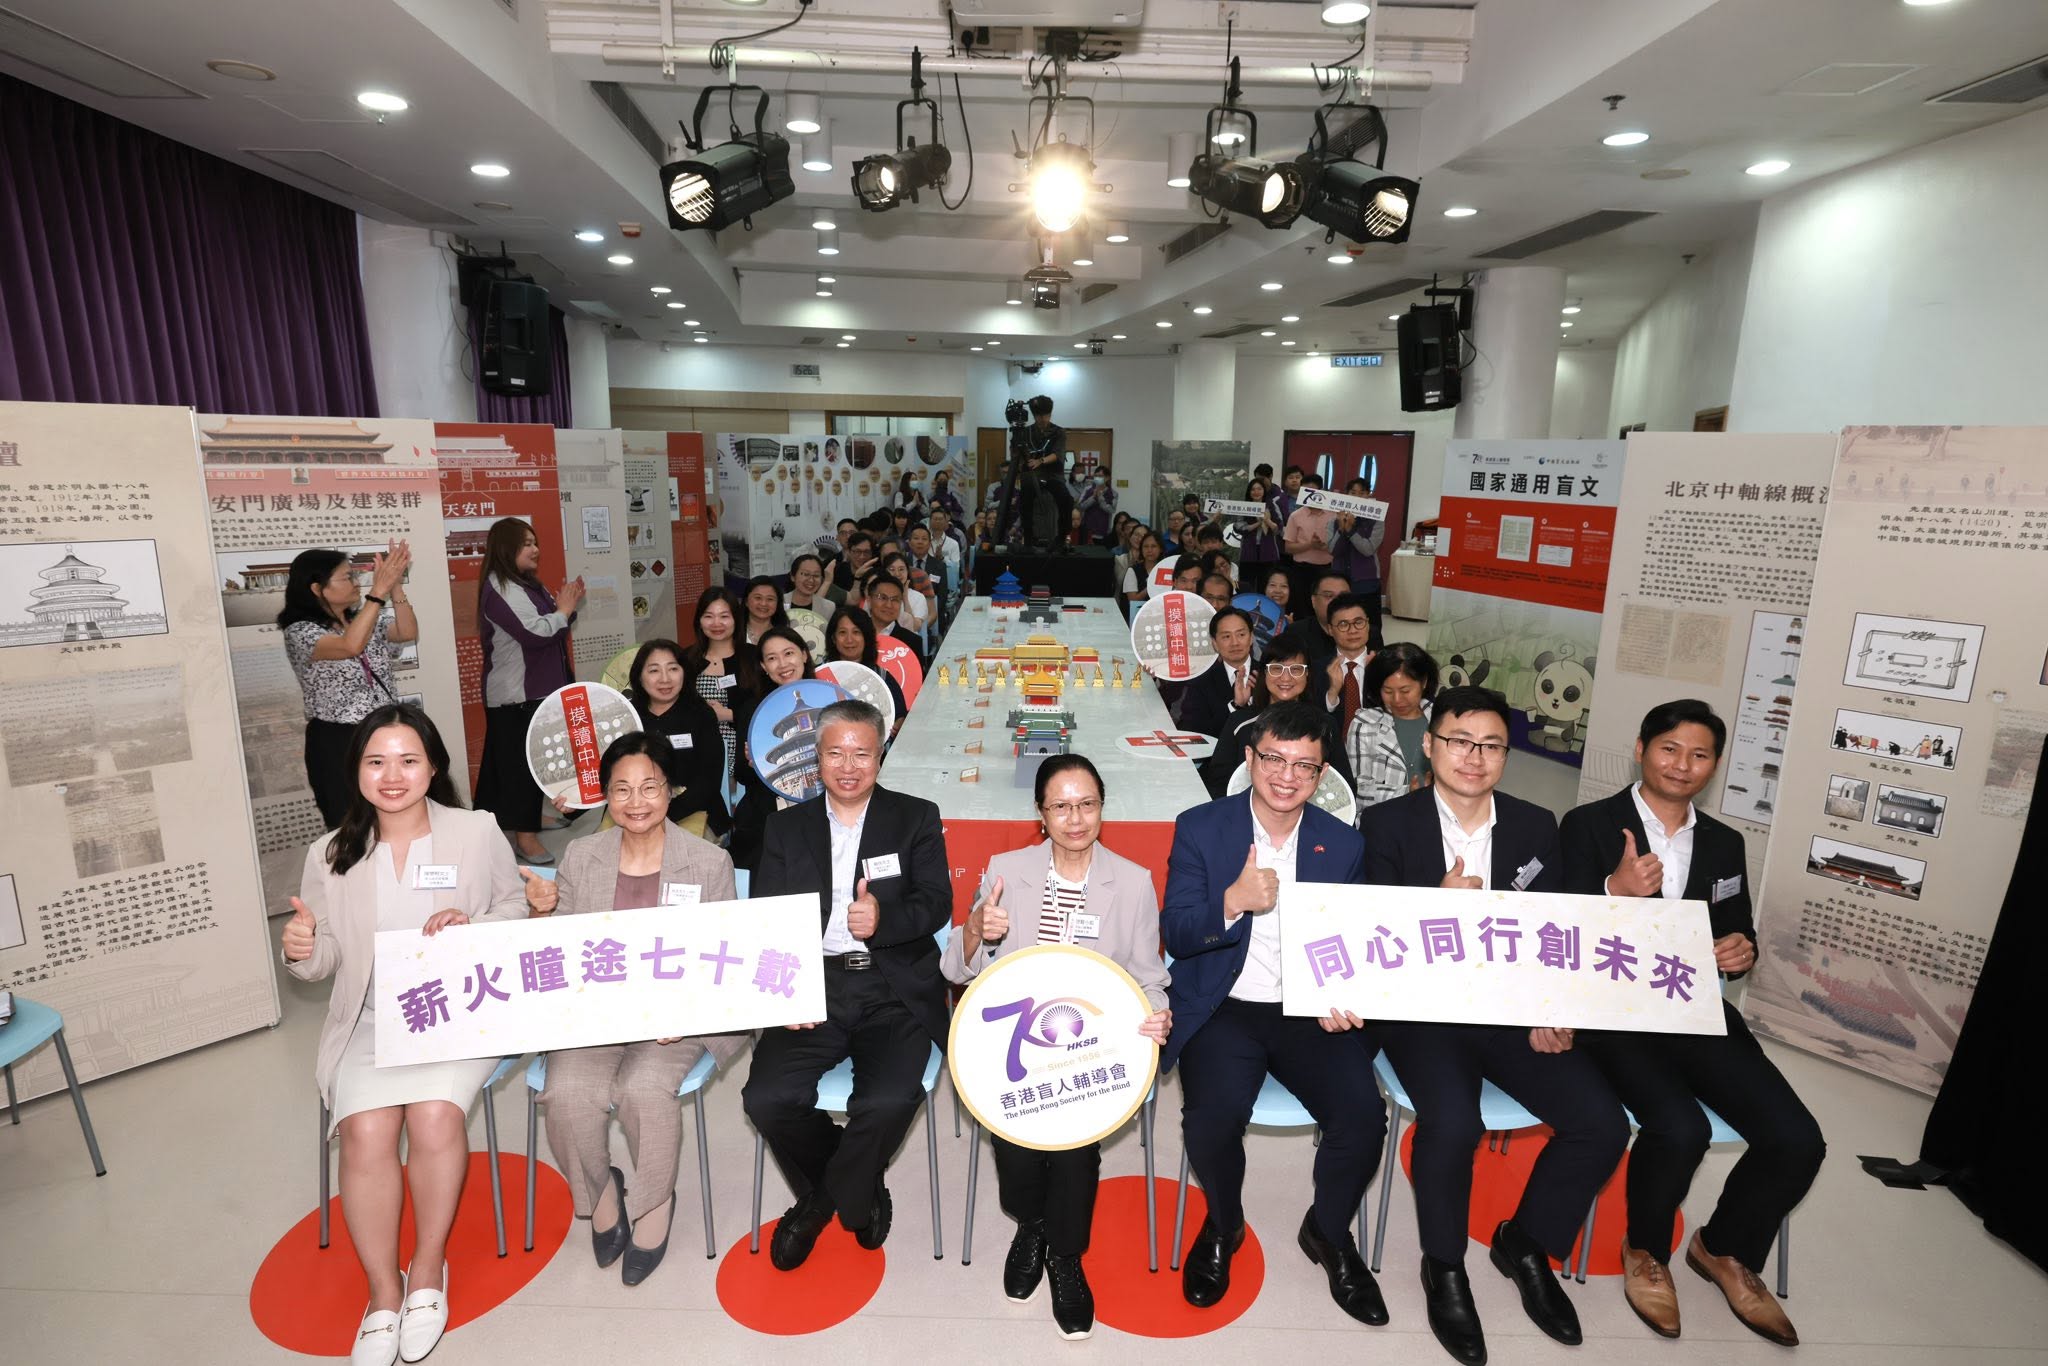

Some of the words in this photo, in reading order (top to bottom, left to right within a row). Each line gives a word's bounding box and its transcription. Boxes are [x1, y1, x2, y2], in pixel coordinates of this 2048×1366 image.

[1335, 357, 1359, 366] EXIT
[1361, 357, 1378, 366] 出口
[1469, 471, 1600, 498] 國家通用盲文
[211, 491, 422, 514] 安門廣場及建築群
[443, 501, 496, 517] 天安門
[1329, 498, 1383, 516] 香港盲人輔導會
[1166, 596, 1187, 677] 『摸讀中軸』
[564, 693, 604, 802] 『摸讀中軸』
[1304, 915, 1697, 1003] 同心同行創未來
[397, 935, 802, 1034] 薪火瞳途七十載
[1066, 1036, 1098, 1052] HKSB
[1047, 1057, 1075, 1072] Since
[1077, 1051, 1100, 1066] 1956
[999, 1063, 1127, 1110] 香港盲人輔導會
[1004, 1110, 1018, 1120] The
[1019, 1104, 1040, 1117] Hong
[1040, 1099, 1059, 1112] Kong
[1060, 1091, 1086, 1107] Society
[1086, 1090, 1097, 1098] for
[1098, 1087, 1110, 1096] the
[1112, 1080, 1131, 1093] Blind
